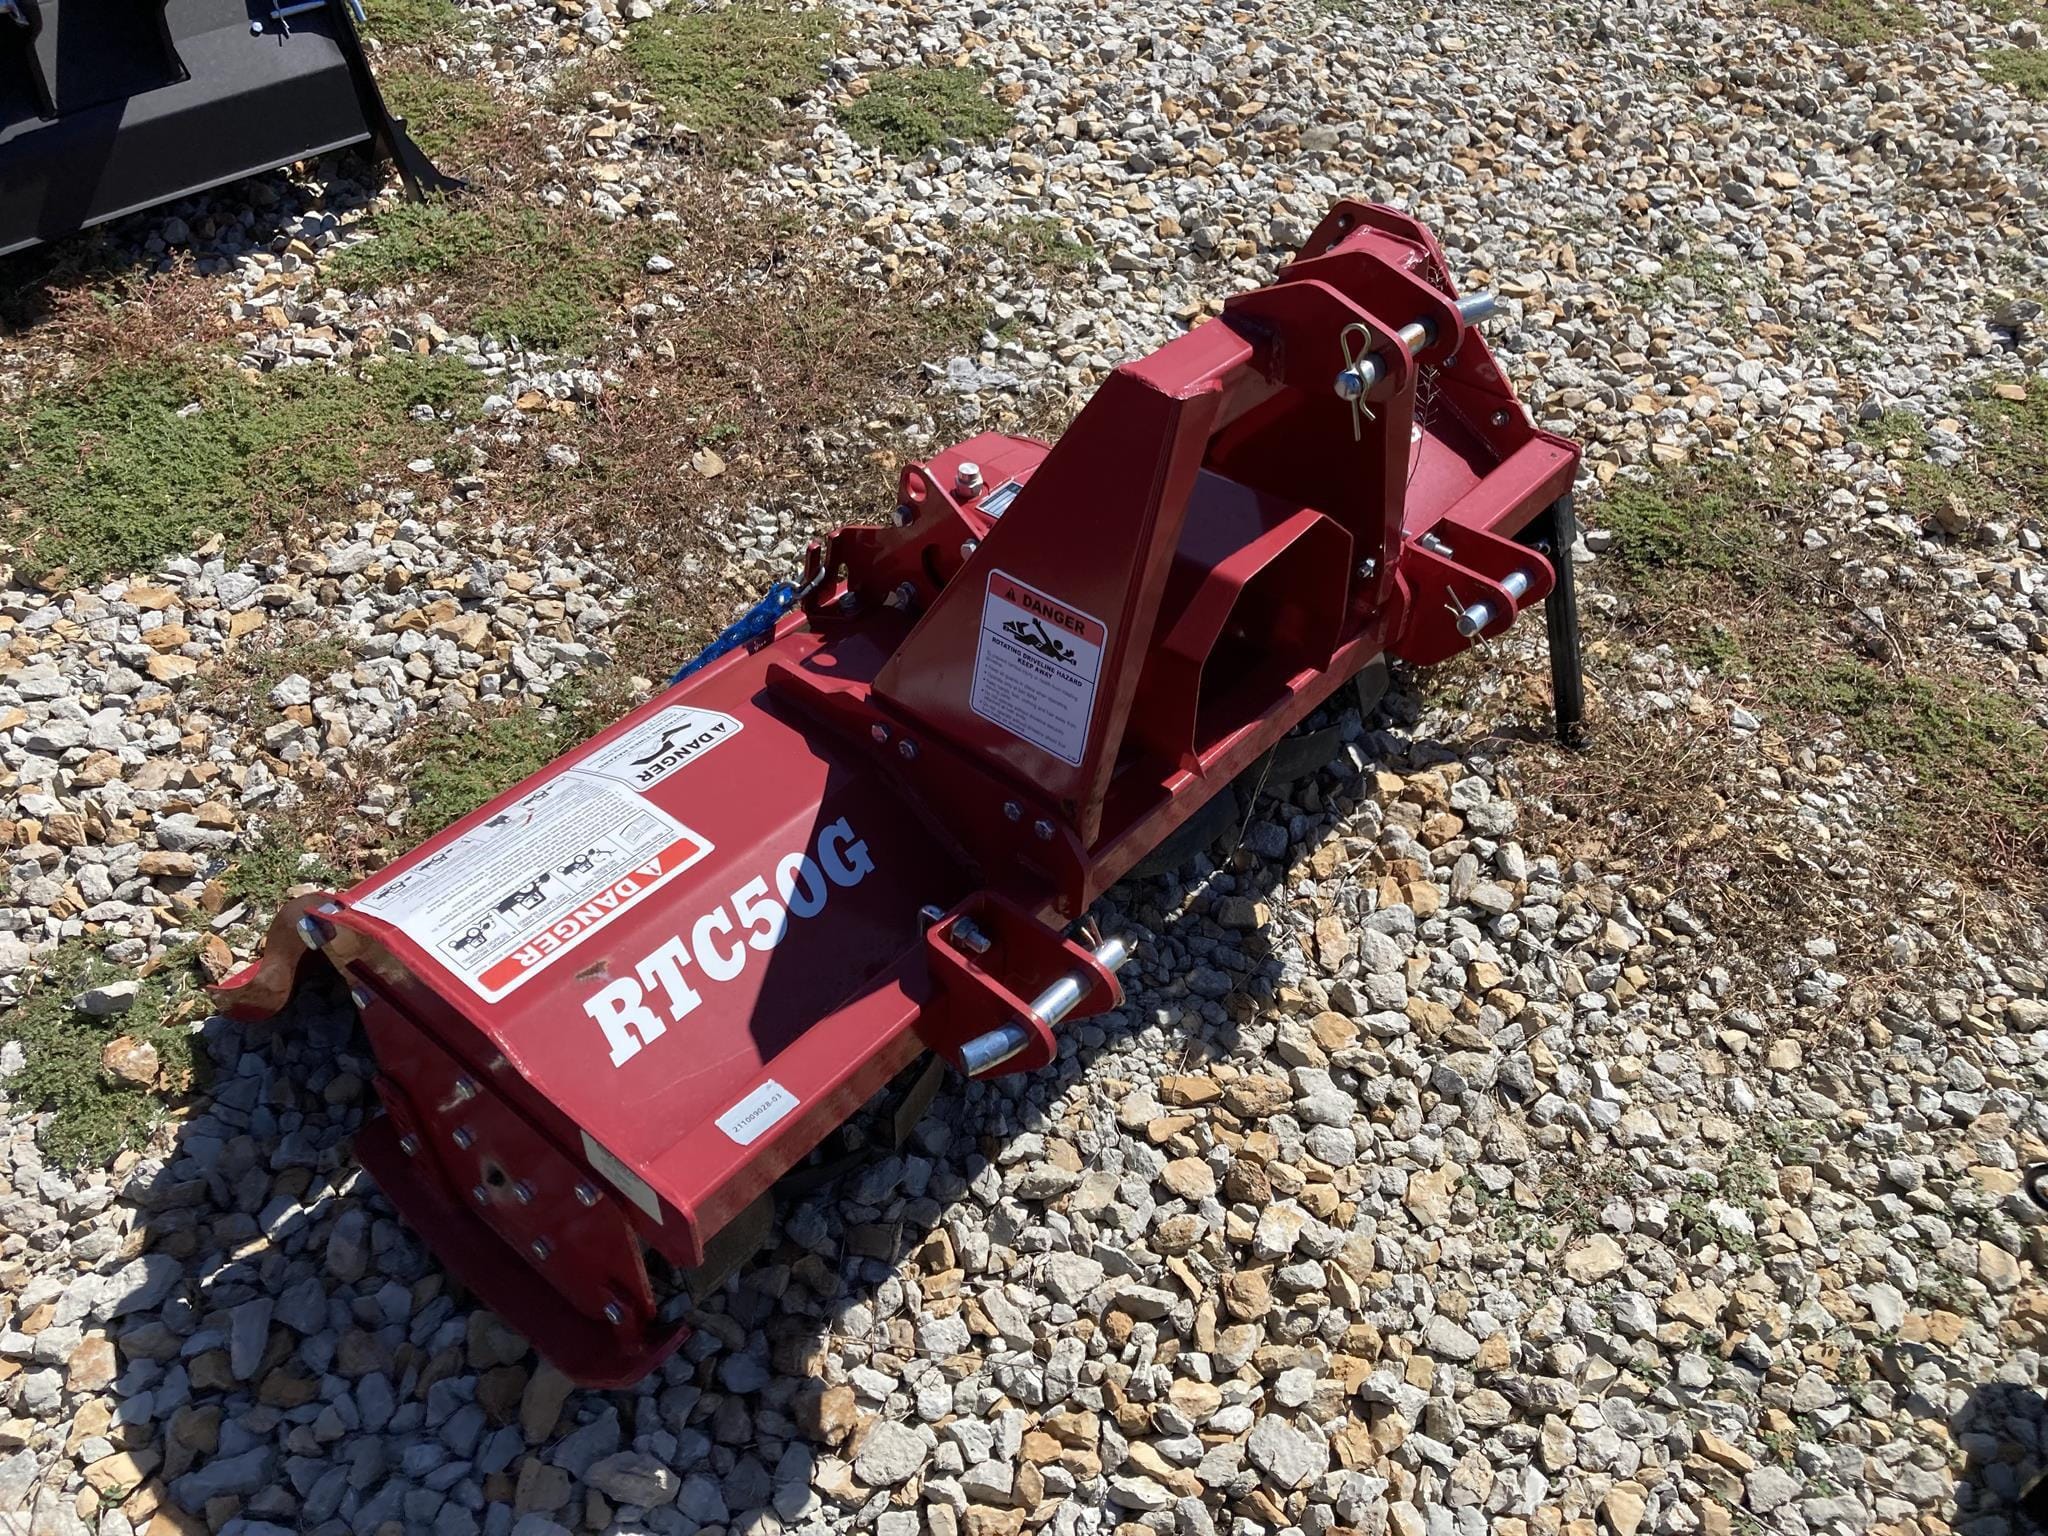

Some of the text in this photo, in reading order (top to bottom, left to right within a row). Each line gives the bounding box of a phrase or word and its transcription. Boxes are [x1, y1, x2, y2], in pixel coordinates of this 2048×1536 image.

[1023, 594, 1085, 635] DANGER
[992, 637, 1082, 687] ROTATING DRIVELINE HAZARD
[1017, 658, 1053, 679] KEEP AWAY
[635, 732, 715, 782] DANGER
[511, 878, 642, 967] DANGER
[582, 816, 875, 1068] RTC50G
